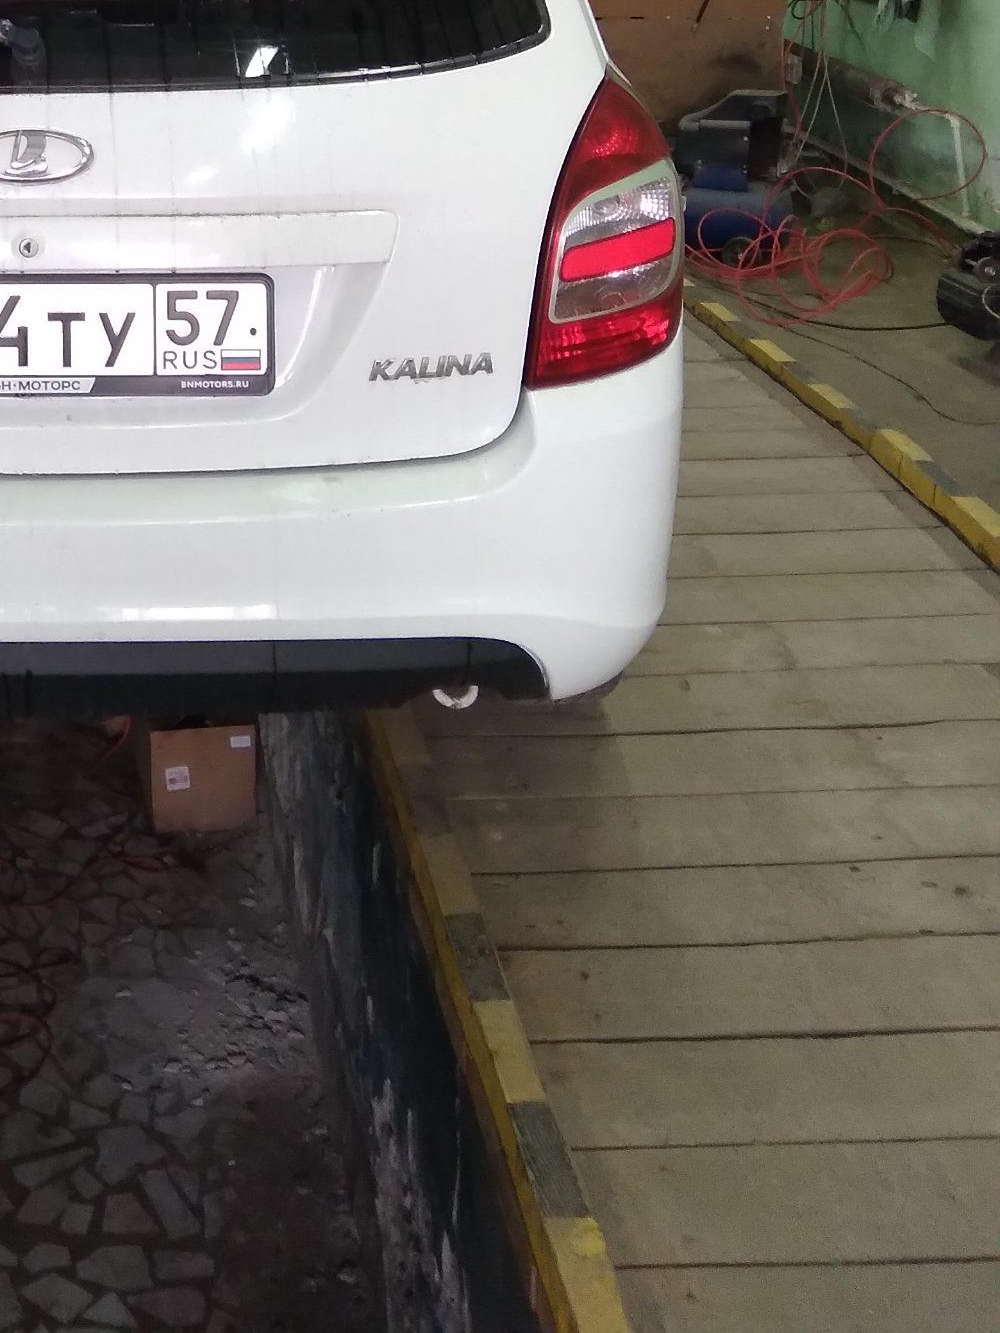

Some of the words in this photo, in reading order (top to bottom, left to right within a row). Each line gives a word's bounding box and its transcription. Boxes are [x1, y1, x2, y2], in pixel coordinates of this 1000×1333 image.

[166, 290, 240, 346] 57
[163, 351, 218, 370] RUS
[369, 352, 493, 381] KALINA
[181, 380, 249, 388] BNMOTORS.RU
